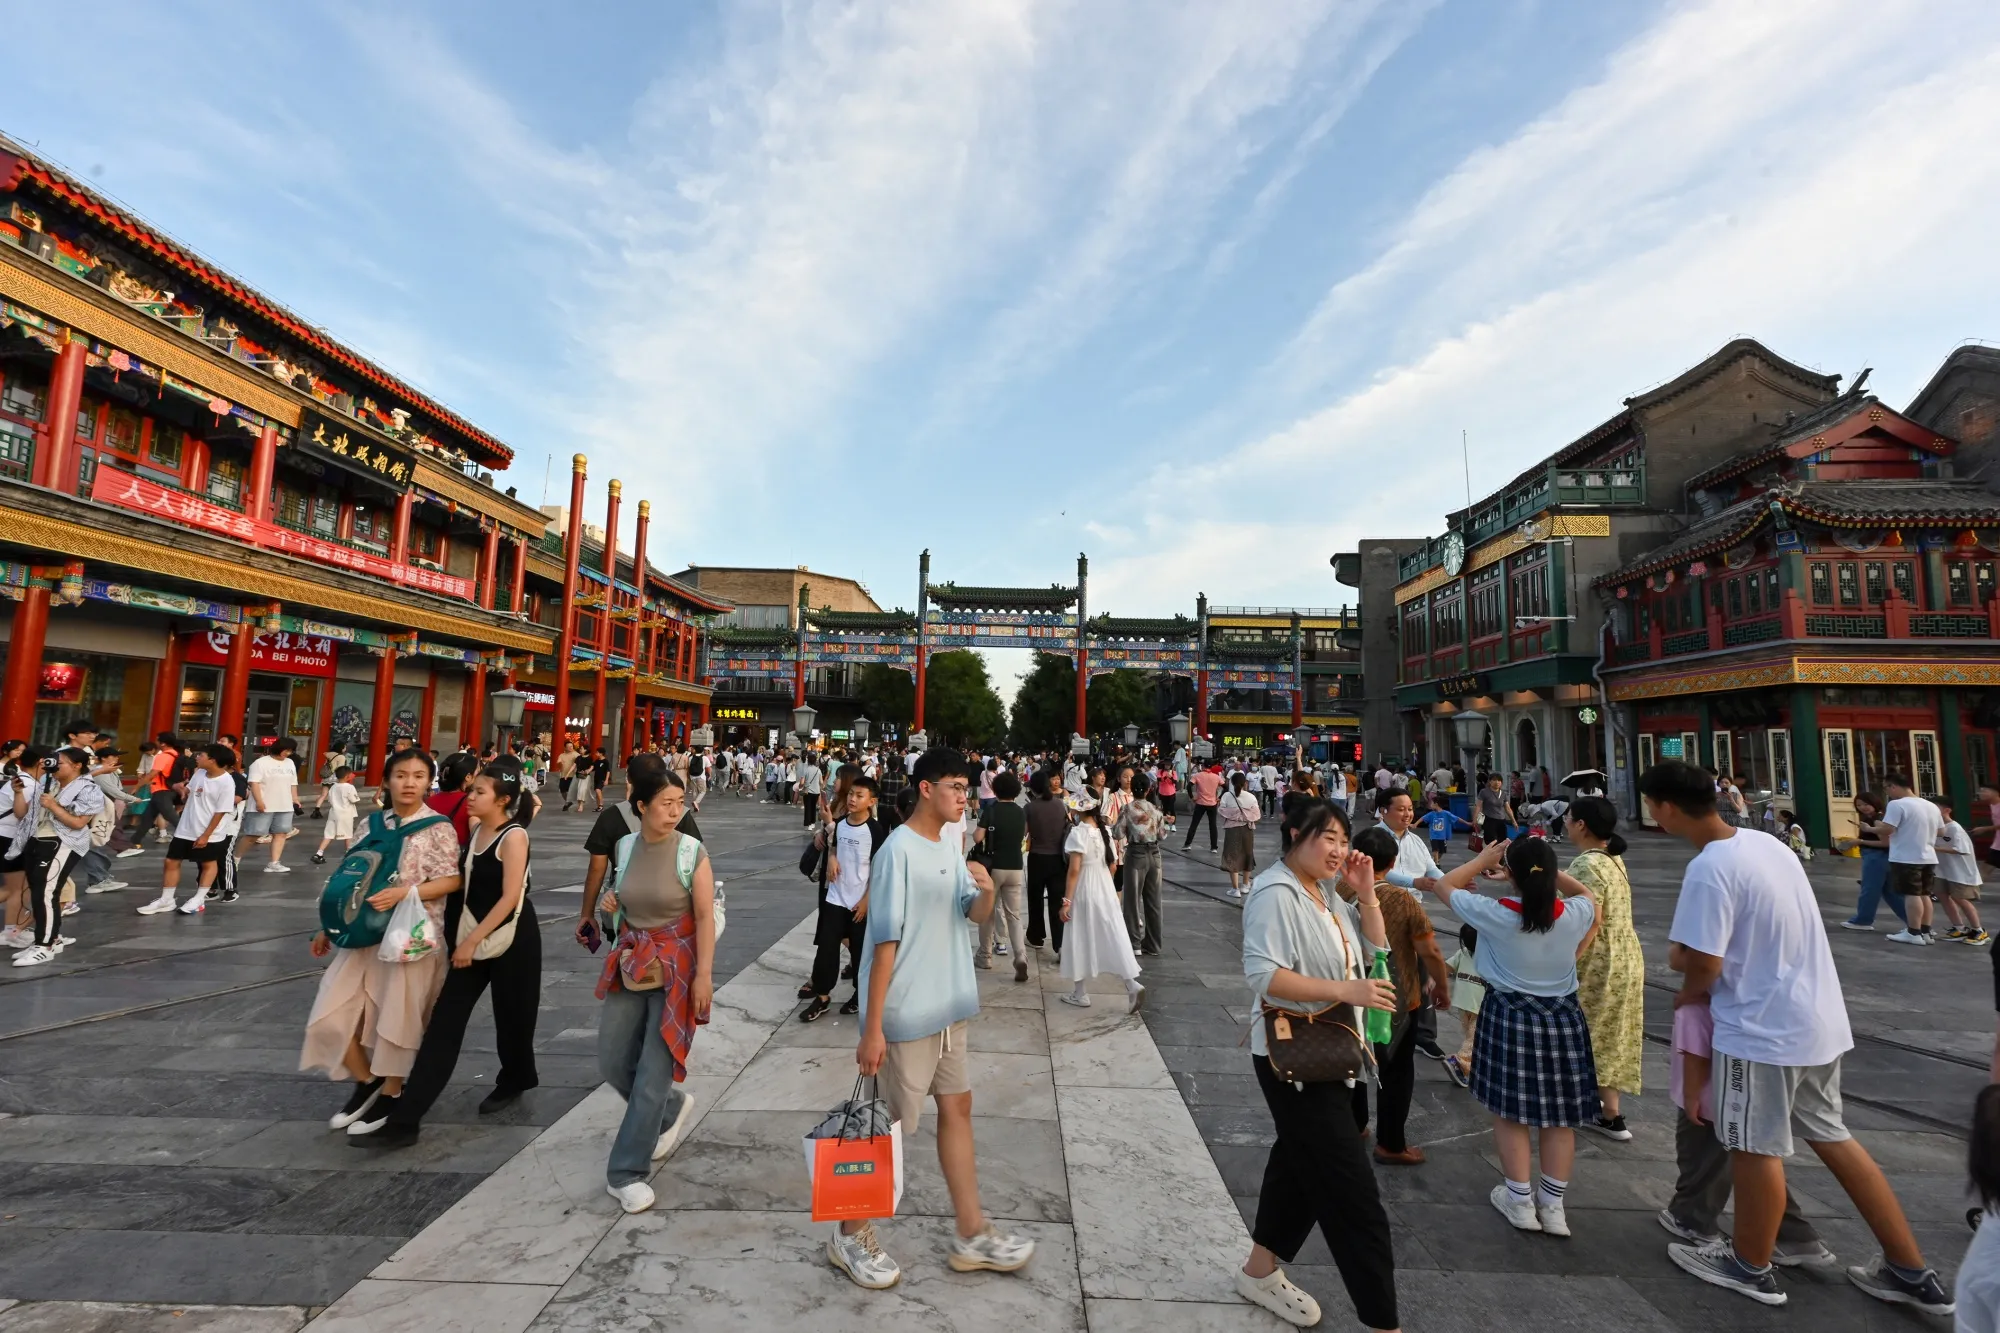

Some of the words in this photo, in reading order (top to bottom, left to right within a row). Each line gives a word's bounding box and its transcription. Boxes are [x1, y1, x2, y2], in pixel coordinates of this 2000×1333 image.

[119, 480, 255, 537] 人人讲安全
[272, 652, 288, 662] BEI
[294, 655, 327, 667] PHOTO
[519, 691, 556, 705] 东便利店
